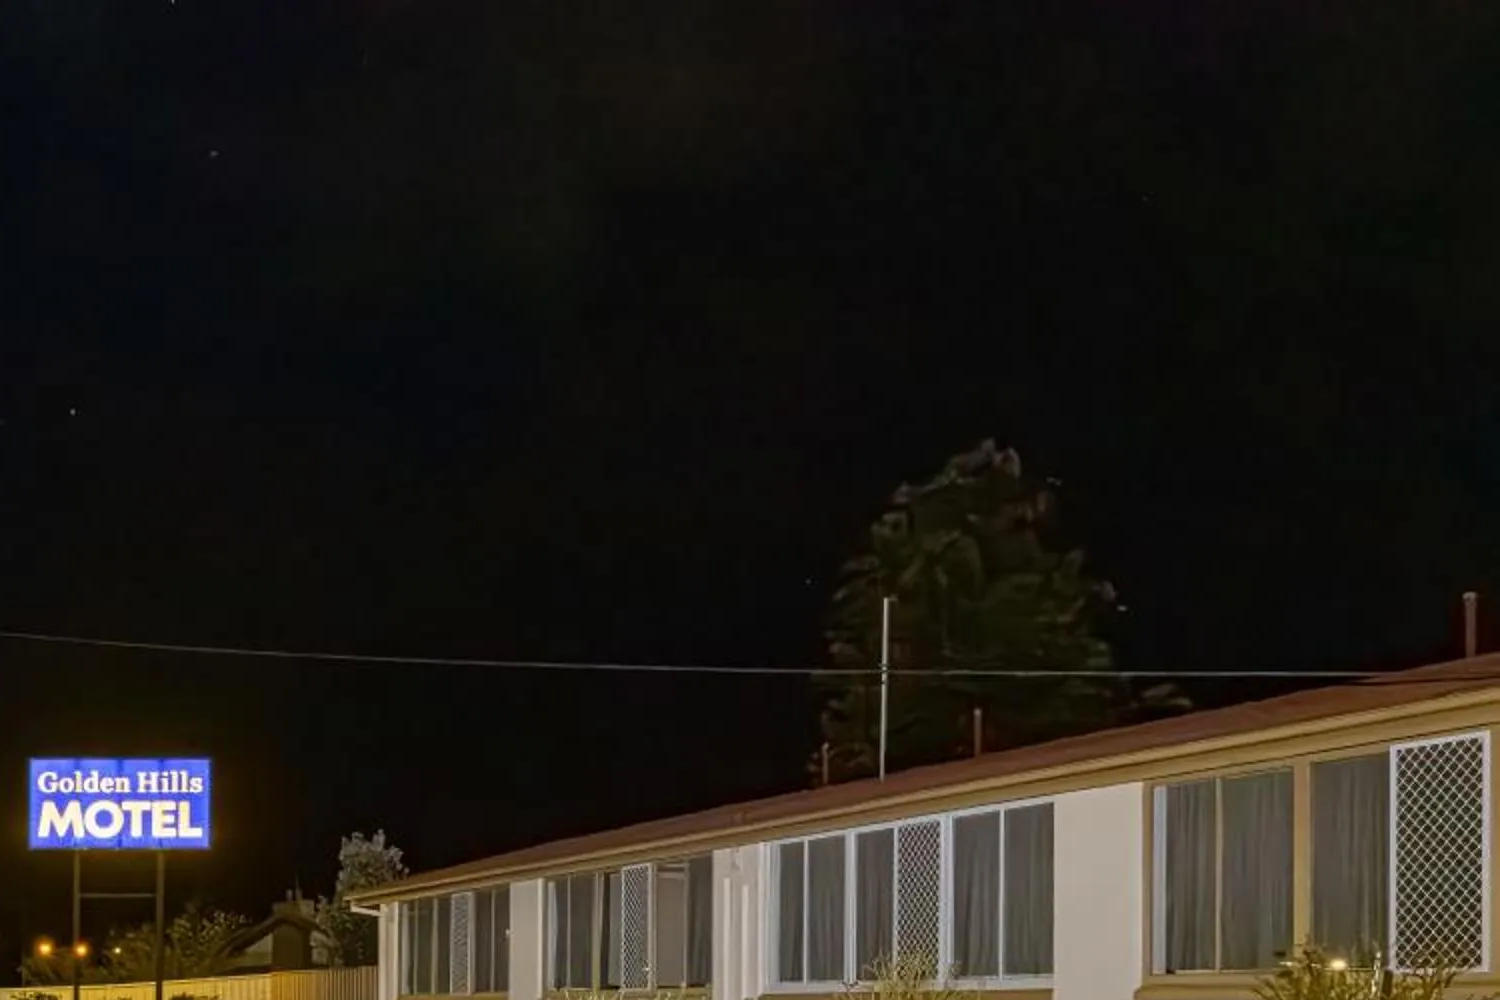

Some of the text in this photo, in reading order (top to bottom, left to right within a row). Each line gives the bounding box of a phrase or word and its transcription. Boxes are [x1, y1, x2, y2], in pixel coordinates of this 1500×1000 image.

[37, 770, 202, 793] Golden Hills
[37, 800, 203, 838] MOTEL
